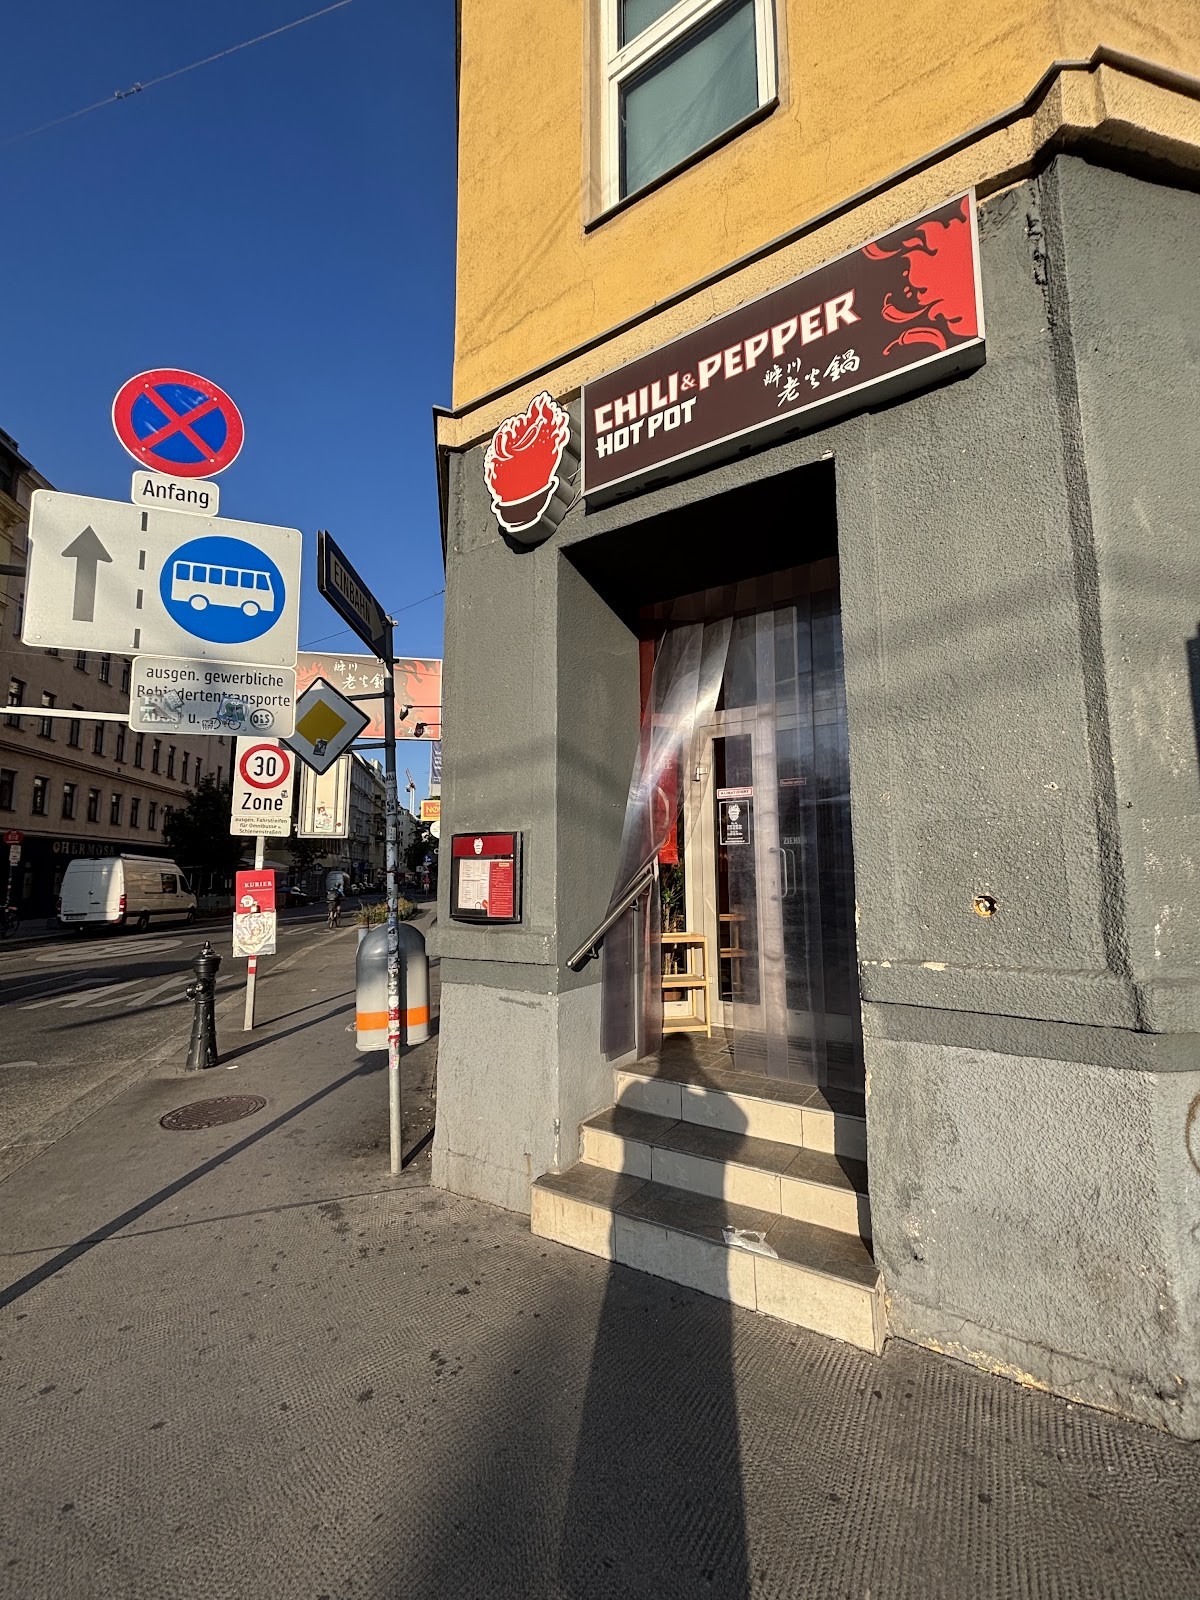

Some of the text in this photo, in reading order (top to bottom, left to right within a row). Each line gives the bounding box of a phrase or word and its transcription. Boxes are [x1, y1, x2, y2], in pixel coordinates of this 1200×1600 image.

[594, 371, 679, 434] CHILI
[698, 289, 861, 391] PEPPER
[595, 396, 697, 459] HOT POT
[142, 479, 209, 509] Anfang
[334, 560, 371, 625] EINBAHN
[146, 667, 284, 687] ausgen. gewerbliche
[253, 756, 276, 777] 30
[241, 792, 283, 811] Zone
[244, 880, 273, 888] KURIER
